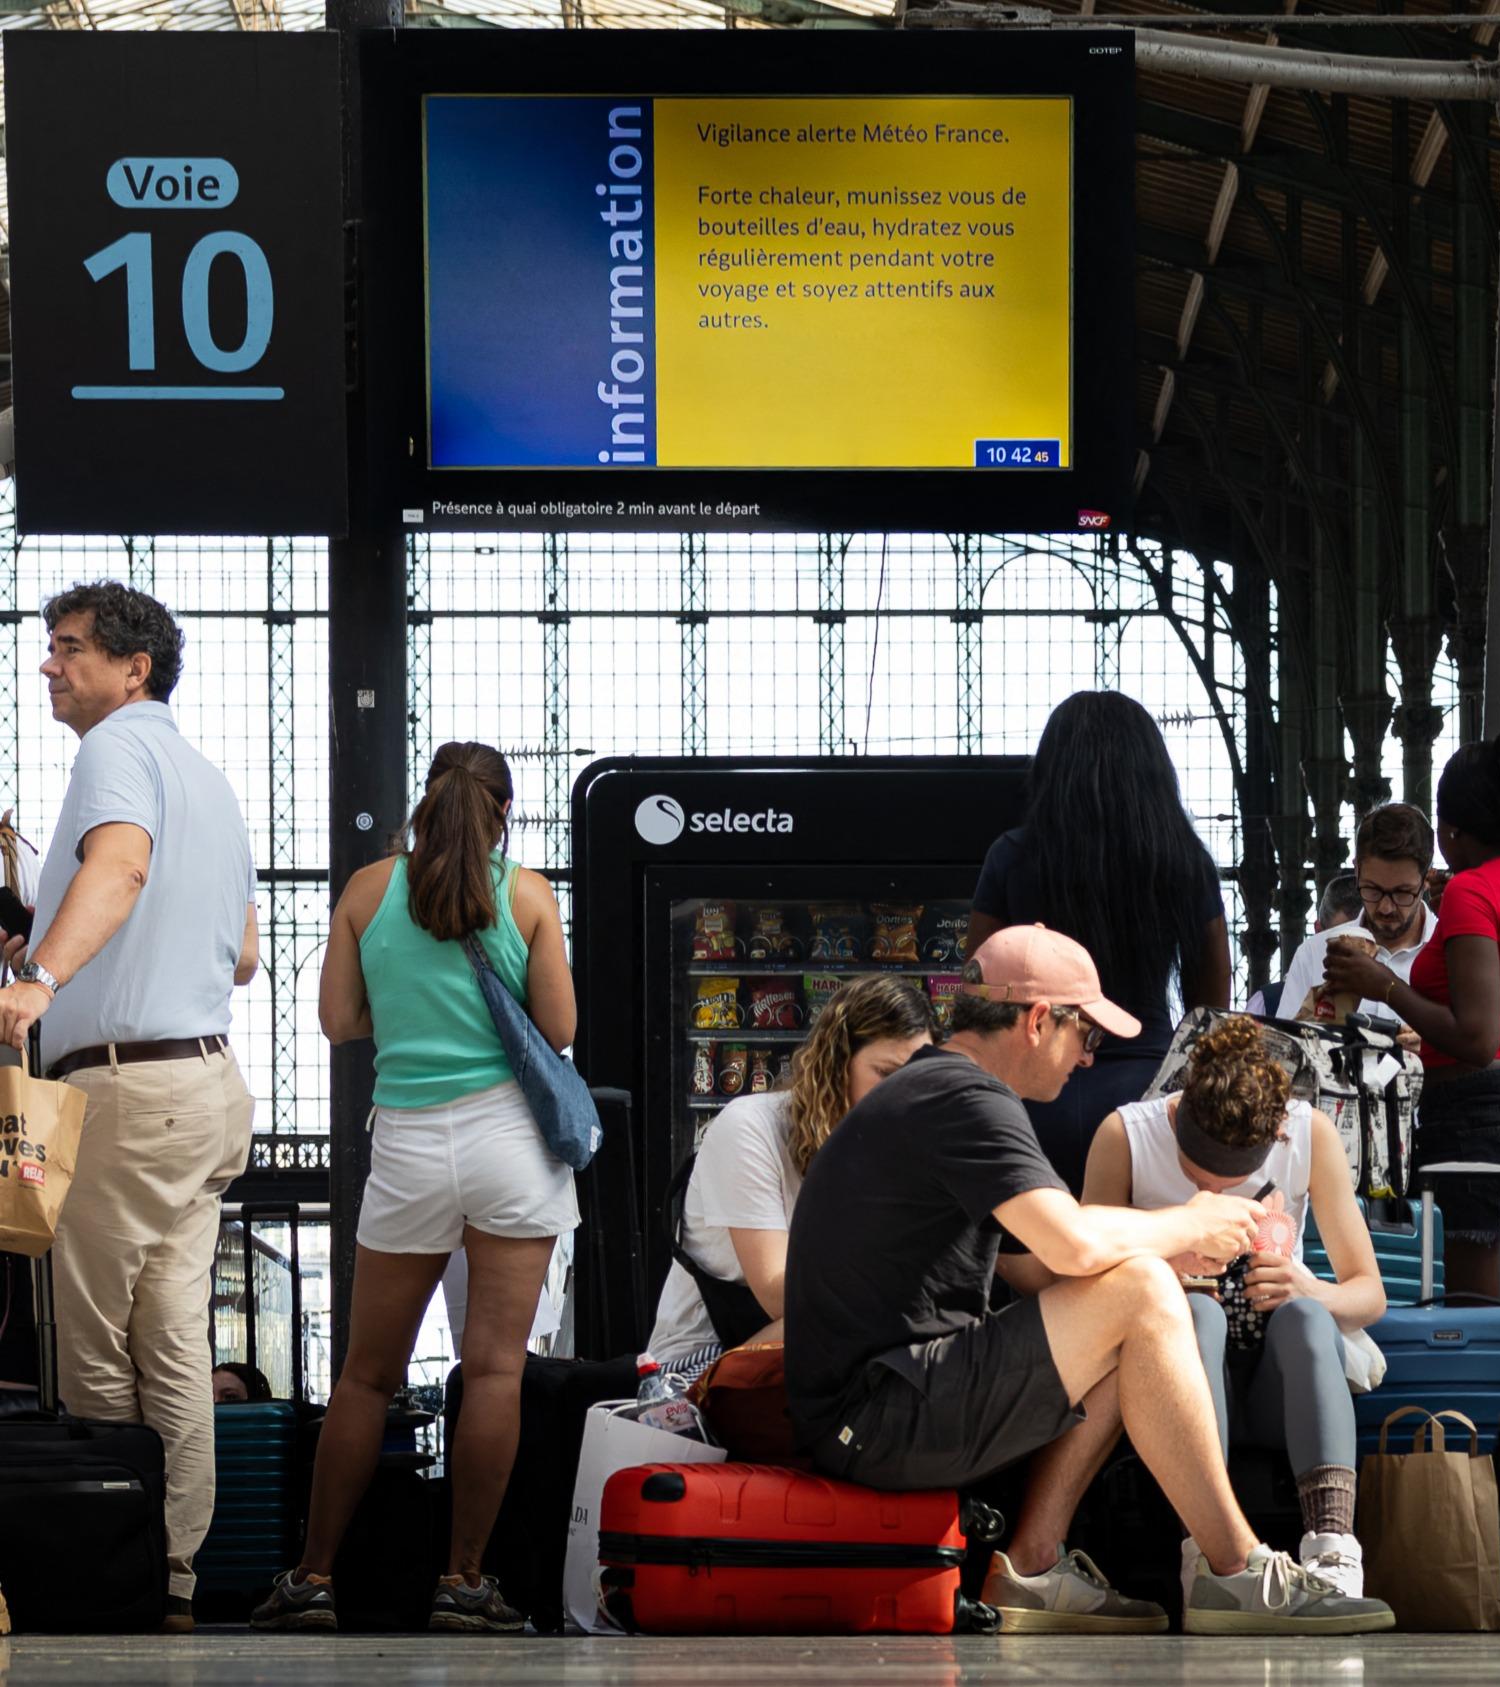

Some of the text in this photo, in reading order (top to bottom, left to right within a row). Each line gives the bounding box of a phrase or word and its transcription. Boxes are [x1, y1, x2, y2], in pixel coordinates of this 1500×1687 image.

[697, 123, 1008, 147] Vigilance alerte Météo France.
[123, 165, 219, 201] Voie
[699, 186, 1025, 207] Forte chaleur, munissez vous de
[699, 217, 1014, 240] bouteilles d'eau, hydratez vous
[700, 248, 994, 270] régulièrement pendant votre
[596, 106, 646, 463] information
[699, 279, 995, 301] voyage et soyez attentifs aux
[84, 231, 273, 372] 10
[699, 312, 768, 329] autres.
[987, 447, 1048, 462] 10 42 45
[433, 502, 759, 517] Présence à quai obligatoire 2 min avant le départ
[1078, 515, 1109, 527] SNCF
[690, 808, 793, 832] selecta
[936, 918, 968, 929] Dorito
[0, 1112, 27, 1136] at
[0, 1137, 46, 1163] ves
